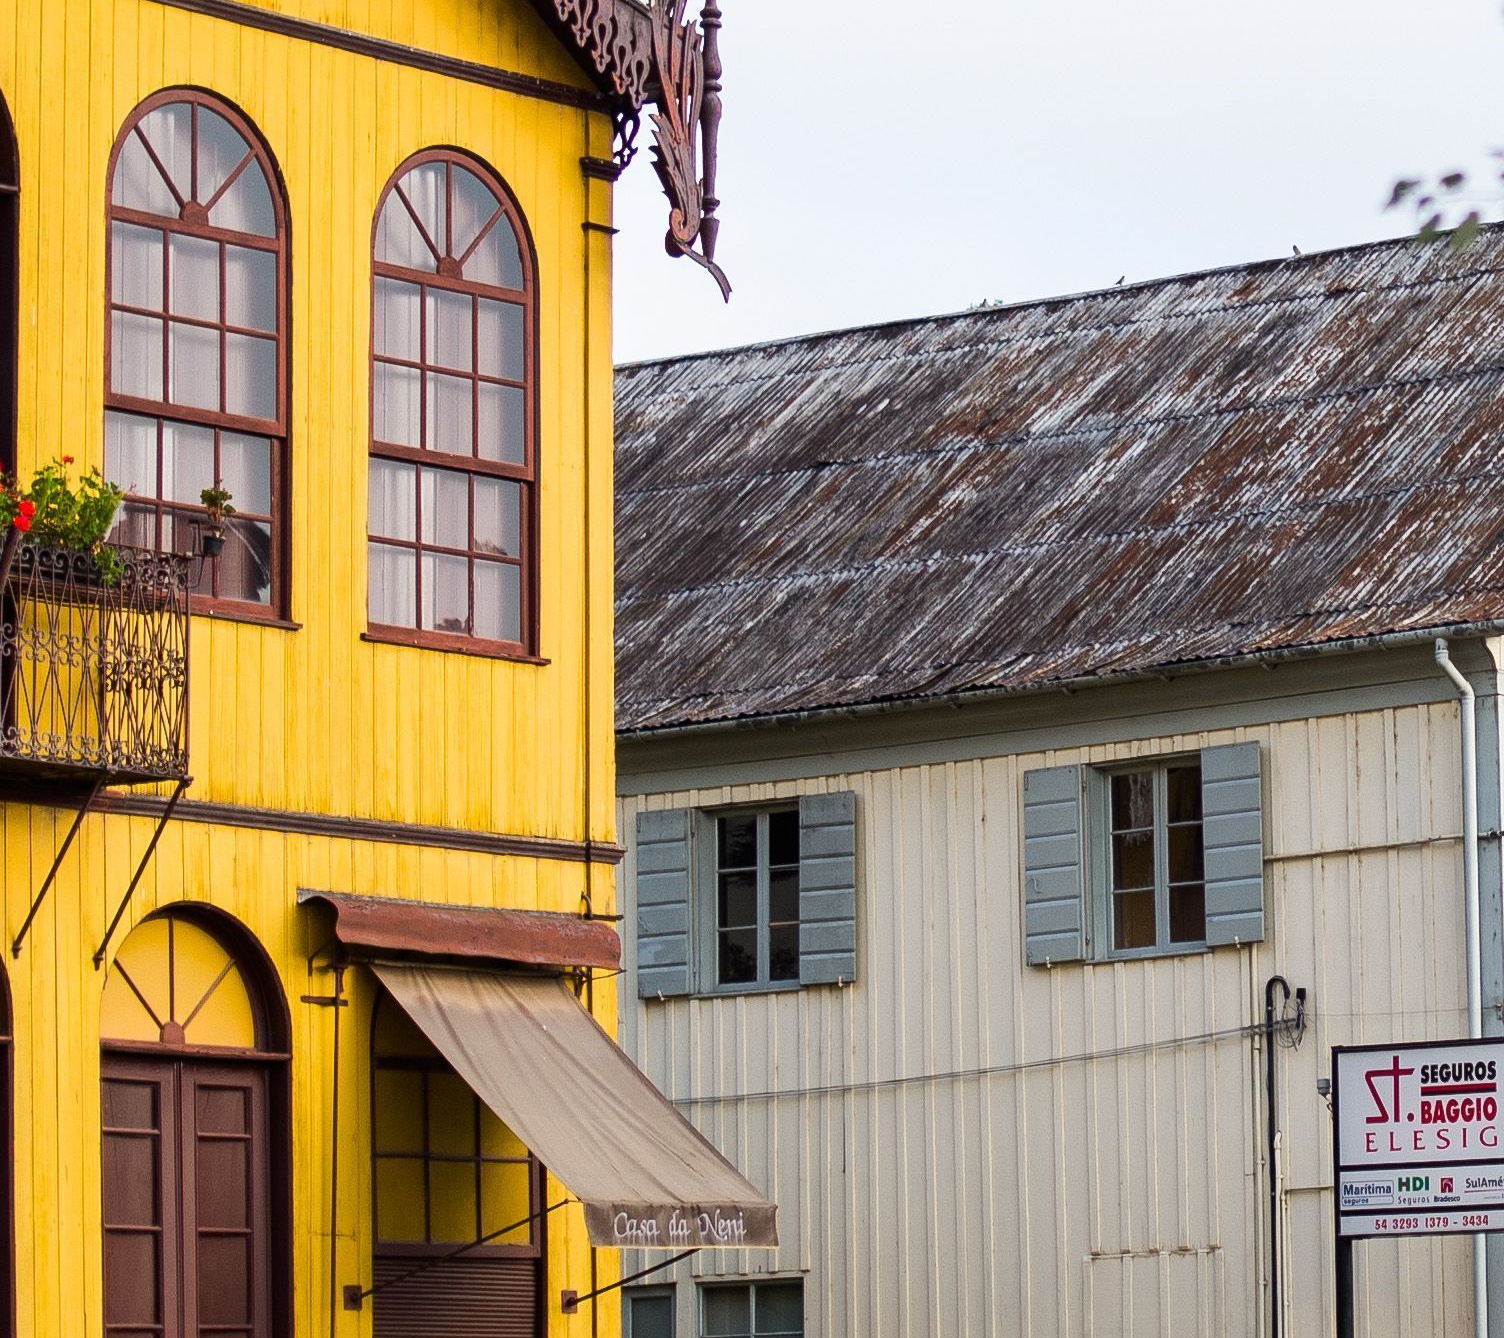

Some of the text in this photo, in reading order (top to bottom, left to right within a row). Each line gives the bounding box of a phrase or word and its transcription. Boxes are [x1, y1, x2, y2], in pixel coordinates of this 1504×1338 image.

[1421, 1061, 1497, 1084] SEGUROS
[1421, 1097, 1498, 1124] BAGGIO
[1366, 1126, 1498, 1152] ELESIG
[1343, 1183, 1392, 1196] Marítima
[1398, 1176, 1429, 1192] HDI
[1397, 1195, 1430, 1205] Seguros
[1433, 1195, 1461, 1203] Bradesco
[614, 1209, 747, 1240] Casa da Neni
[1375, 1219, 1388, 1230] 54
[1392, 1217, 1419, 1230] 3293
[1424, 1216, 1449, 1228] 1379
[1462, 1214, 1489, 1227] 3434
